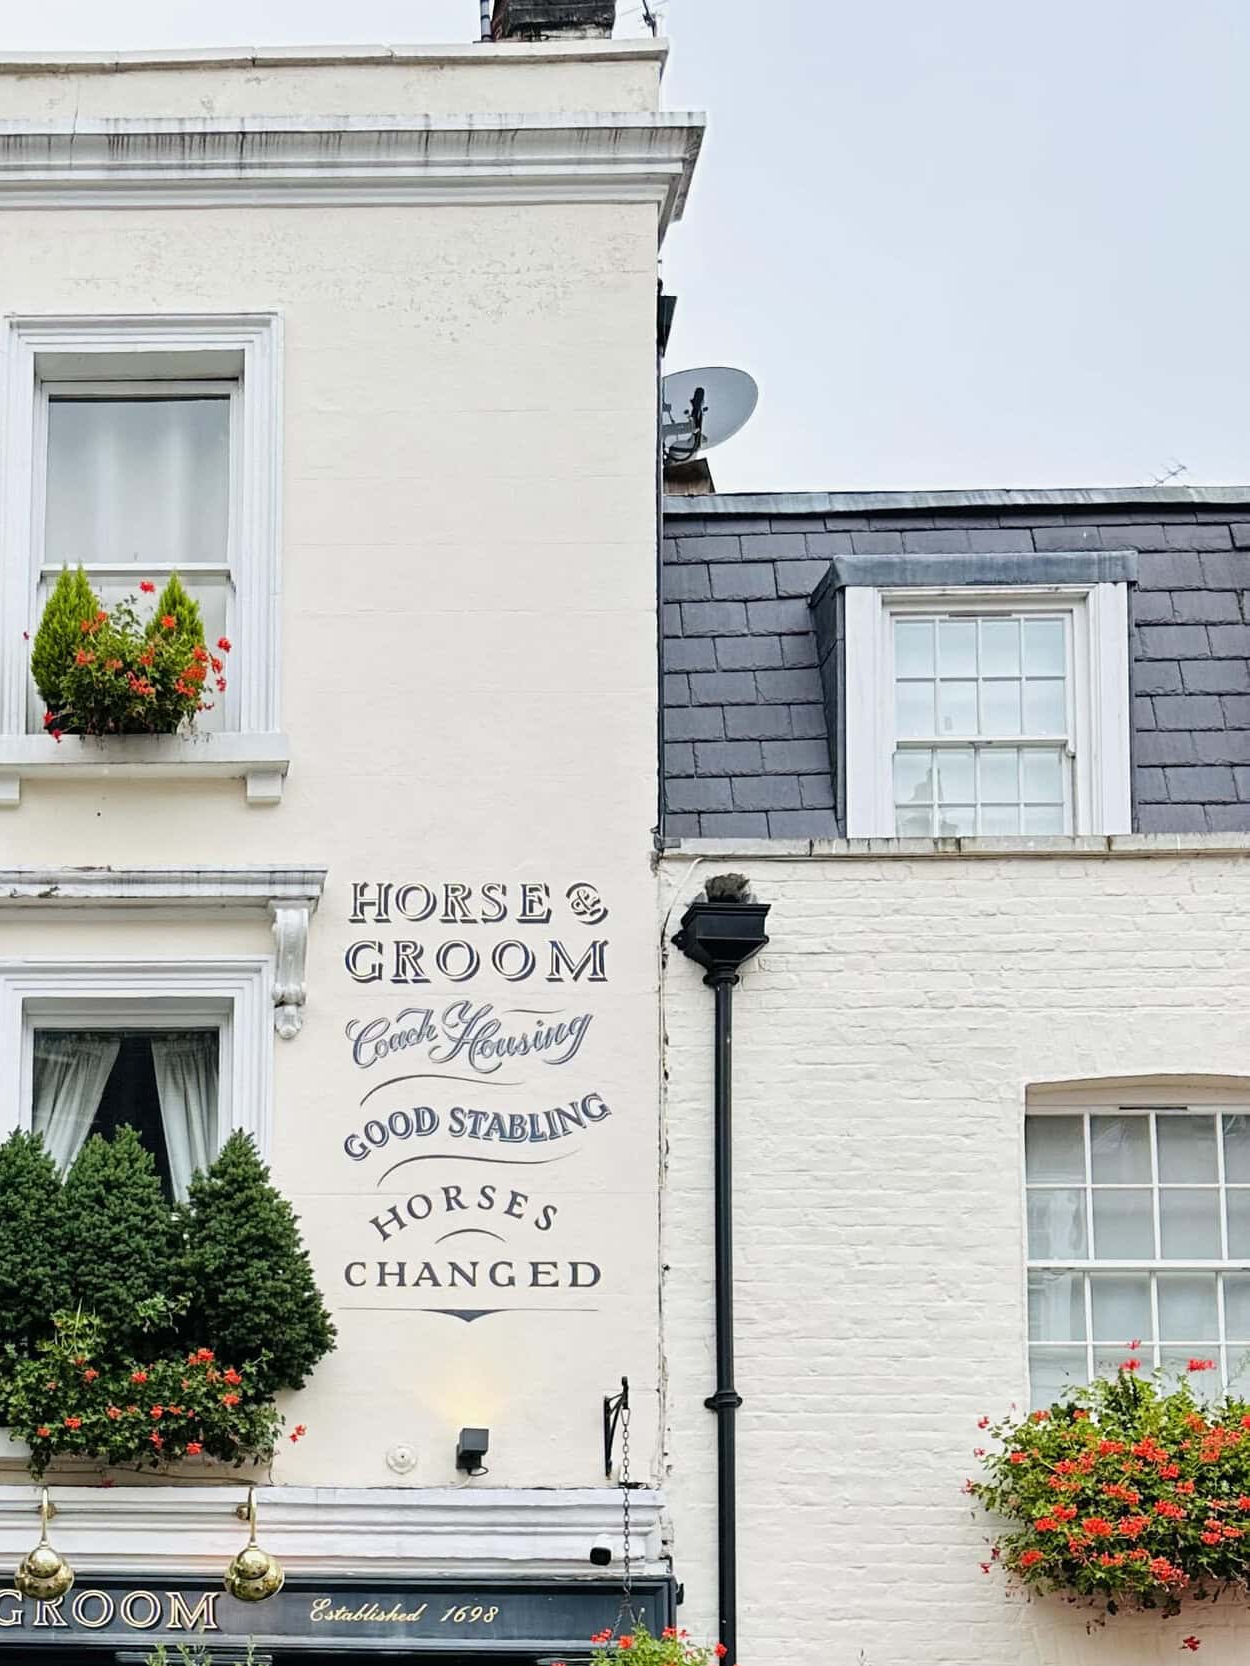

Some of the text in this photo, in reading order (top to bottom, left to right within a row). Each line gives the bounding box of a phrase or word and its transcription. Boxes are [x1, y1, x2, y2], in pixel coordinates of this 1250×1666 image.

[347, 881, 609, 925] HORSE &
[344, 938, 610, 984] GROOM
[344, 999, 594, 1074] Coach Housing
[343, 1092, 613, 1161] GOOD STABLING
[368, 1184, 558, 1242] HORSES
[343, 1260, 602, 1288] CHANGED
[309, 1597, 500, 1624] Established 1698
